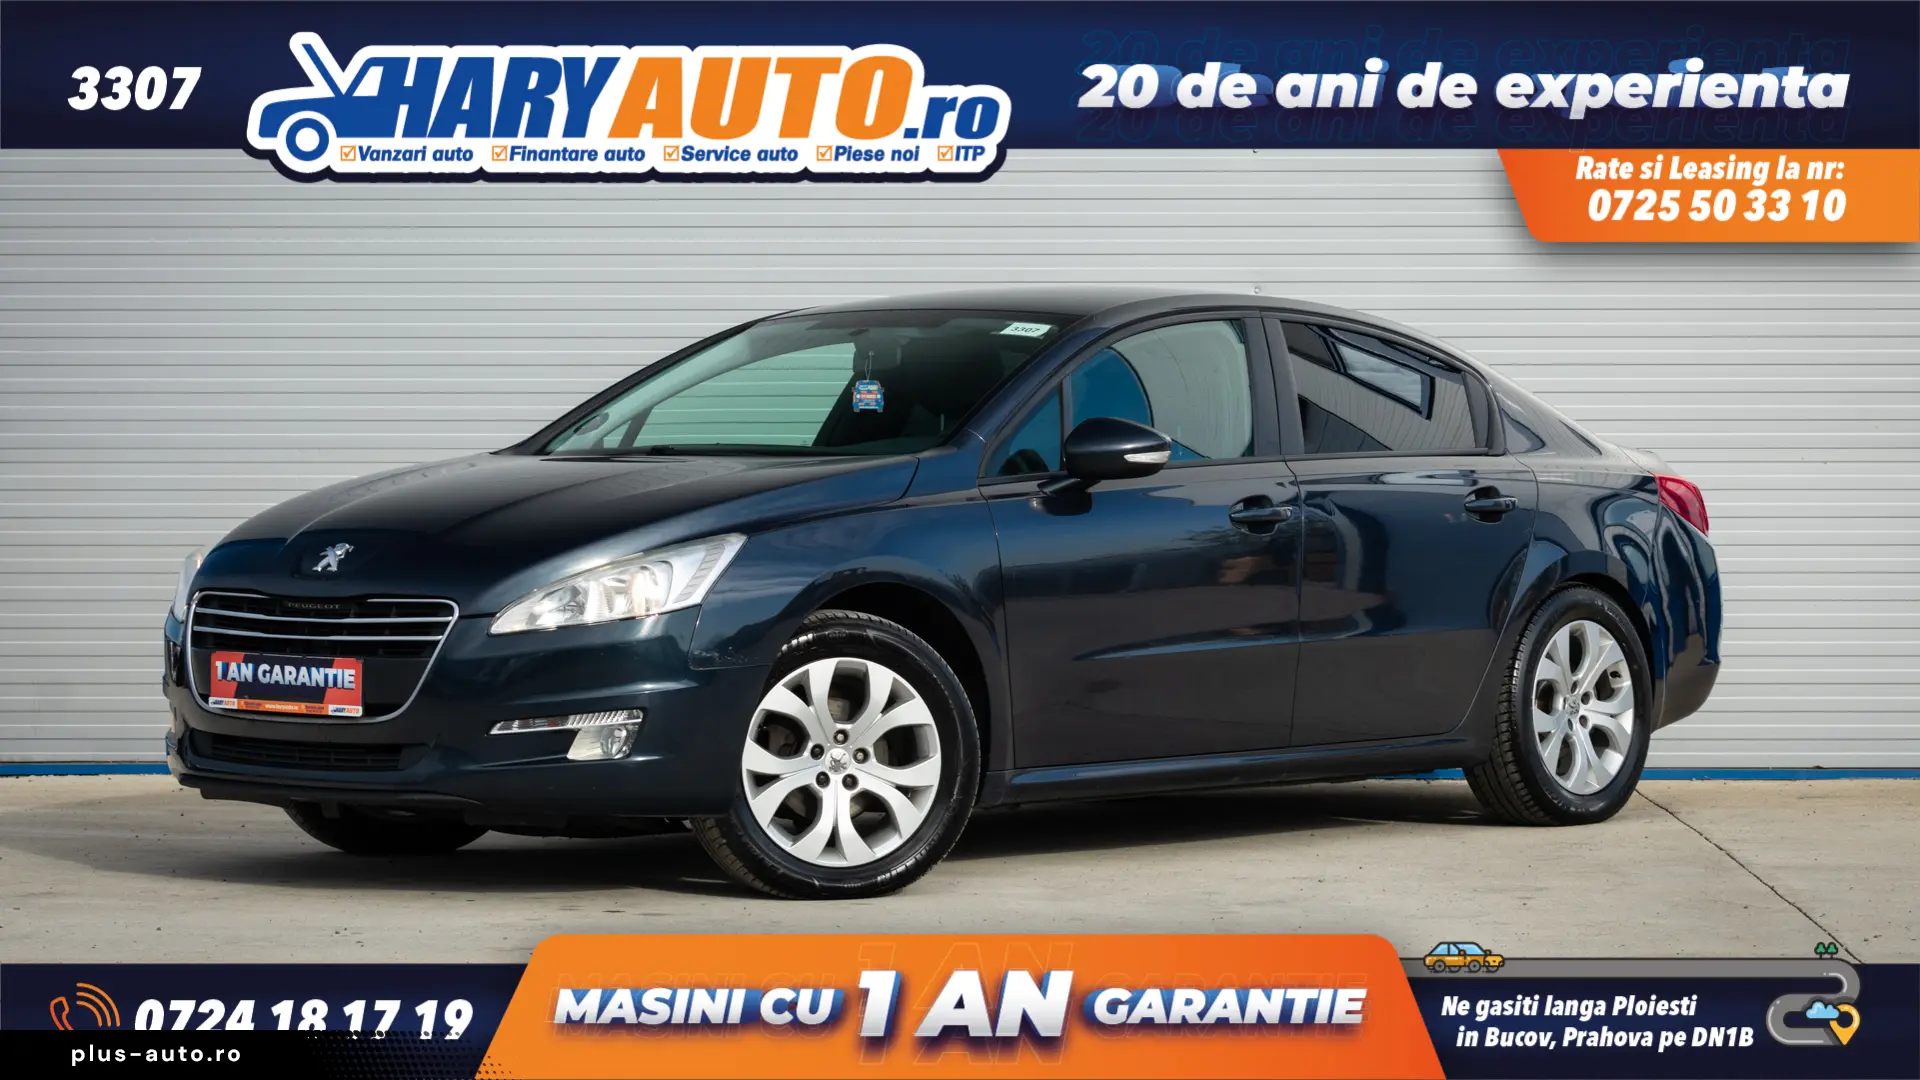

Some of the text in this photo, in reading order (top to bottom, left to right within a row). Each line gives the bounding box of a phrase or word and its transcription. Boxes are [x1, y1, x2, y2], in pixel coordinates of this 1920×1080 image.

[215, 660, 356, 689] 1 AN GARANTIE
